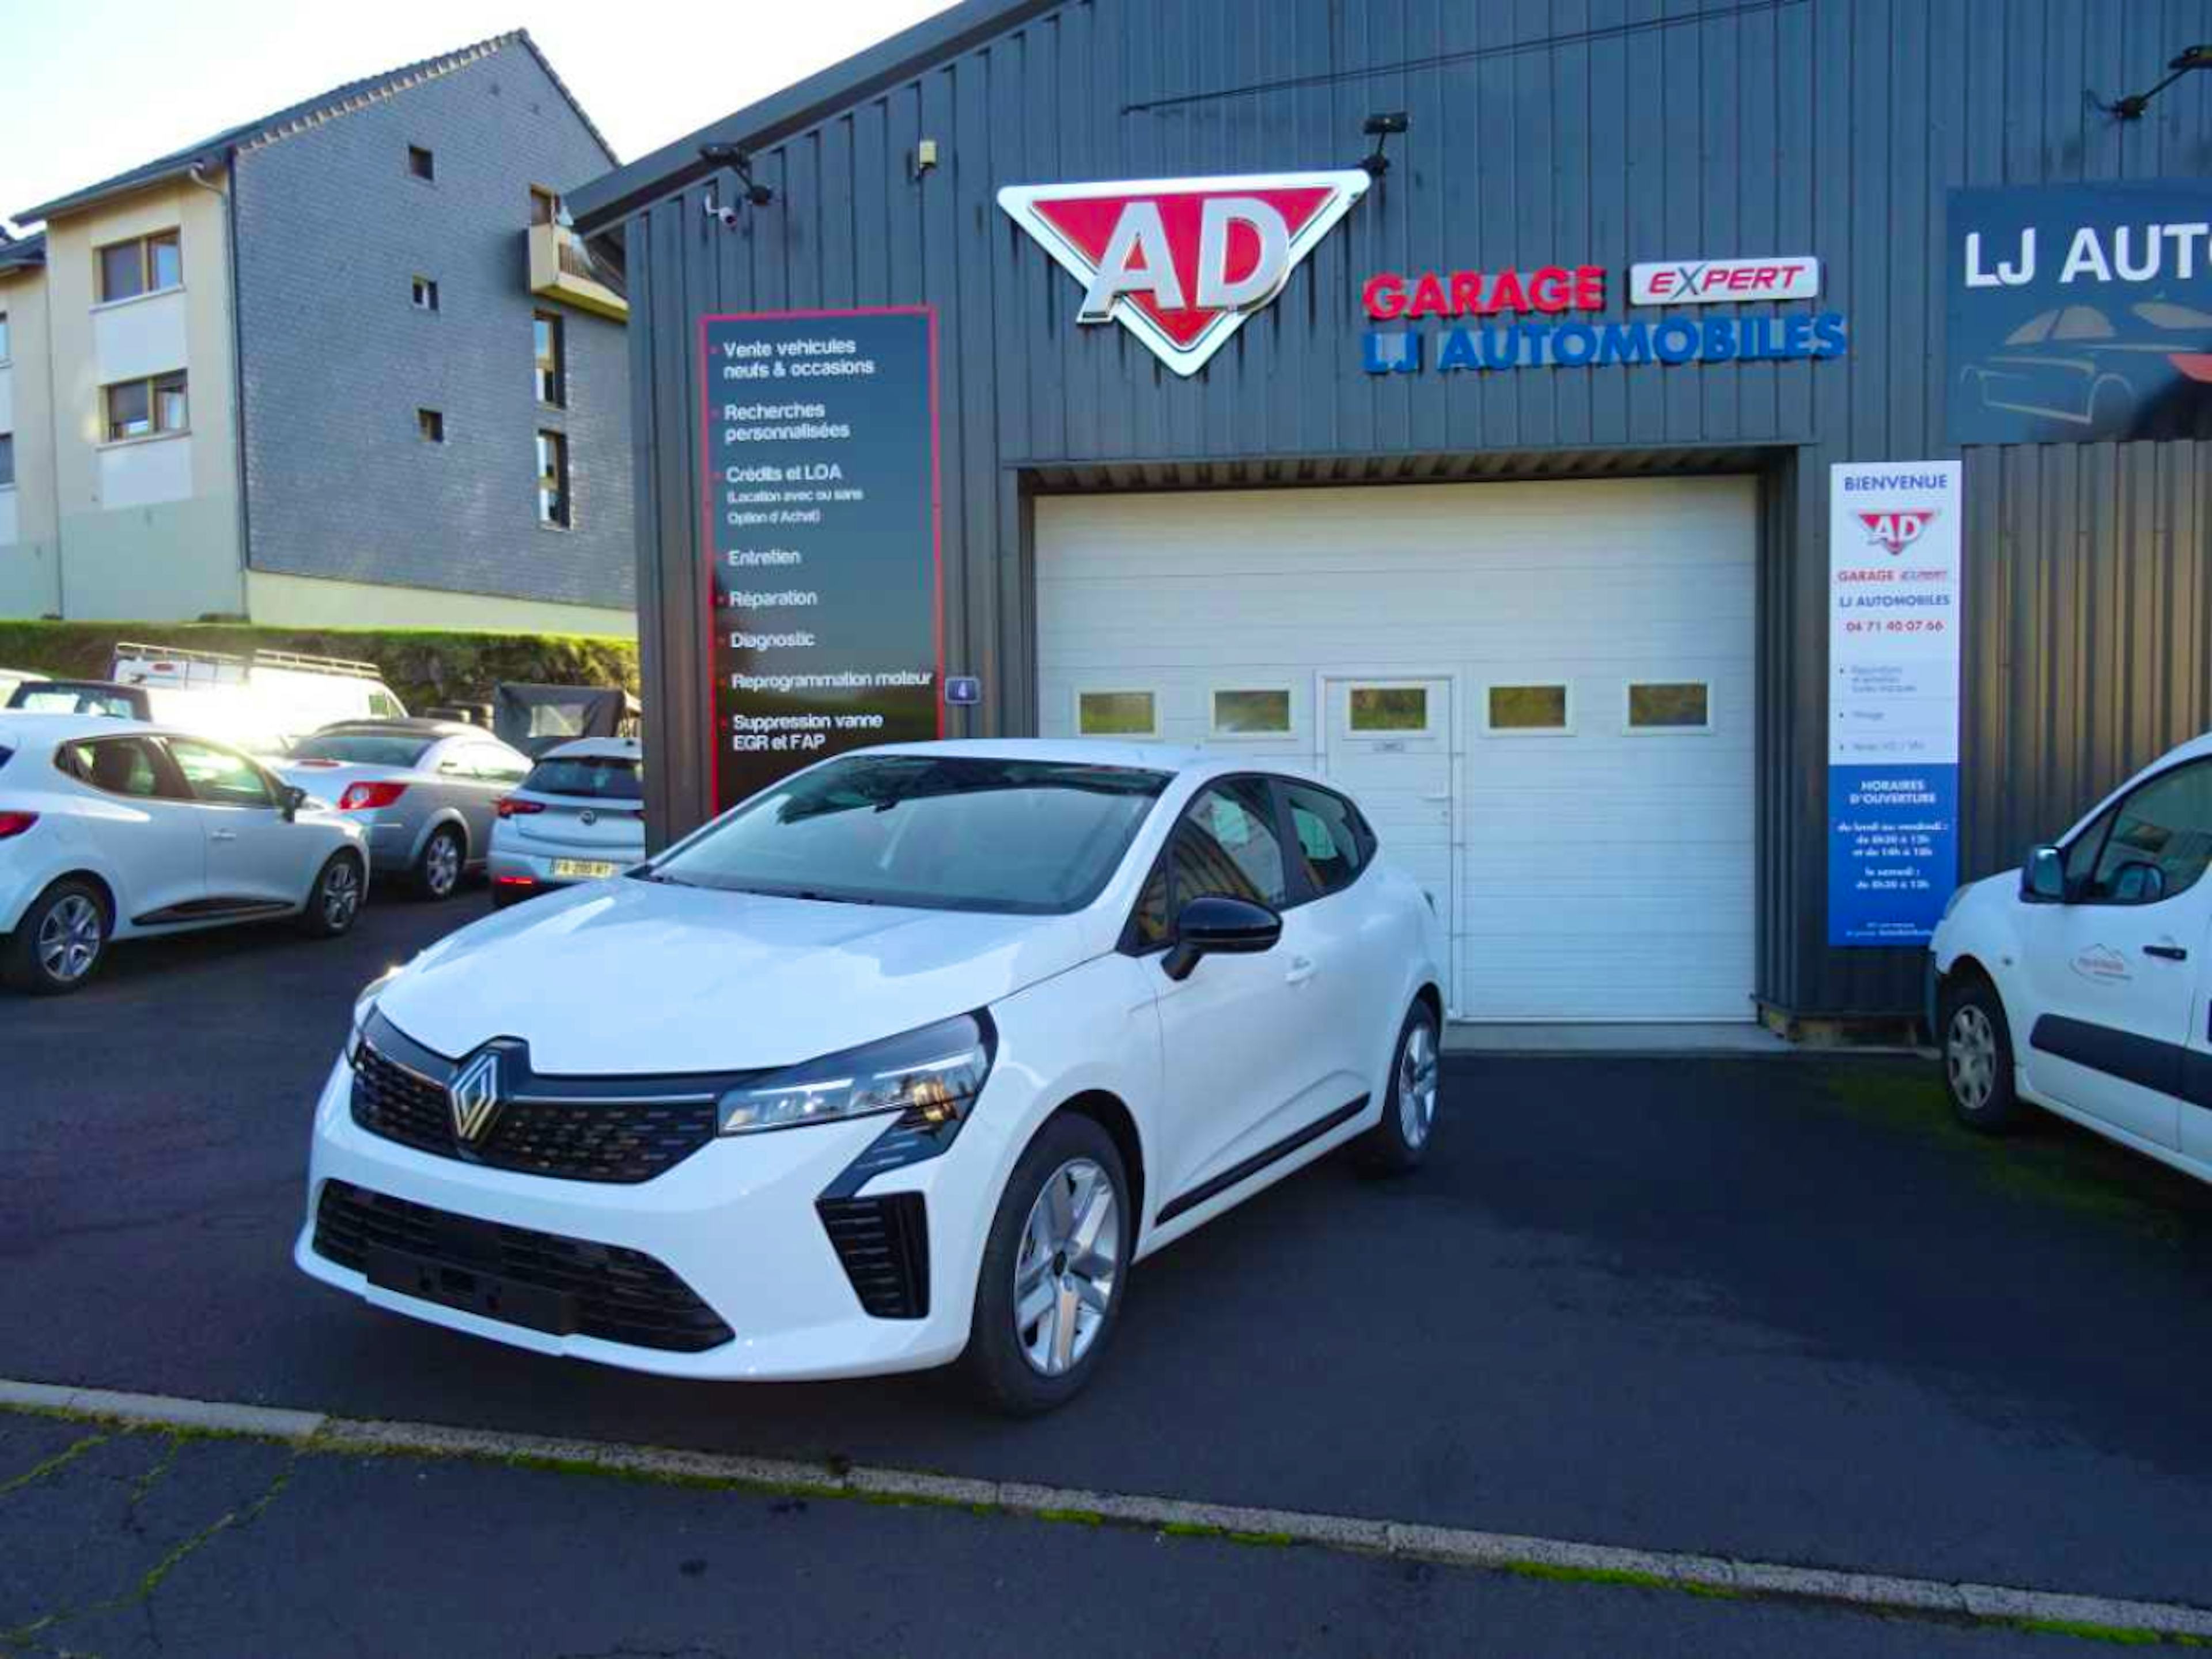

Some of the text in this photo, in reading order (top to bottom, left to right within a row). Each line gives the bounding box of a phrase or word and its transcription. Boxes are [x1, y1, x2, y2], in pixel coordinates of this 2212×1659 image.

[1077, 196, 1290, 325] AD
[1964, 222, 2212, 287] LJ AUT
[1647, 263, 1805, 302] EXPERT
[1361, 265, 1608, 320] GARAGE
[723, 341, 772, 358] Vente
[1361, 312, 1847, 374] LJ AUTOMOBILES
[724, 358, 875, 380] neufs & occasions
[724, 402, 825, 421] Recherches
[725, 422, 850, 444] personnalisées
[726, 464, 843, 482] Crédits et LOA
[1844, 474, 1948, 491] BIENVENUE
[784, 491, 814, 502] avec
[816, 490, 831, 501] ou
[834, 489, 863, 501] sans
[727, 511, 767, 525] Option
[728, 550, 801, 566] Entretien
[1838, 569, 1894, 582] GARAGE
[729, 590, 818, 610] Réparation
[1855, 593, 1950, 608] AUTOMOBILES
[730, 632, 816, 652] Diagnostic
[732, 671, 933, 692] Reprogrammation moteur
[733, 713, 884, 735] Suppression vanne
[733, 733, 826, 751] EGR et FAP
[1860, 780, 1926, 792] HORAIRES
[1849, 792, 1937, 806] D'OUVERTURE
